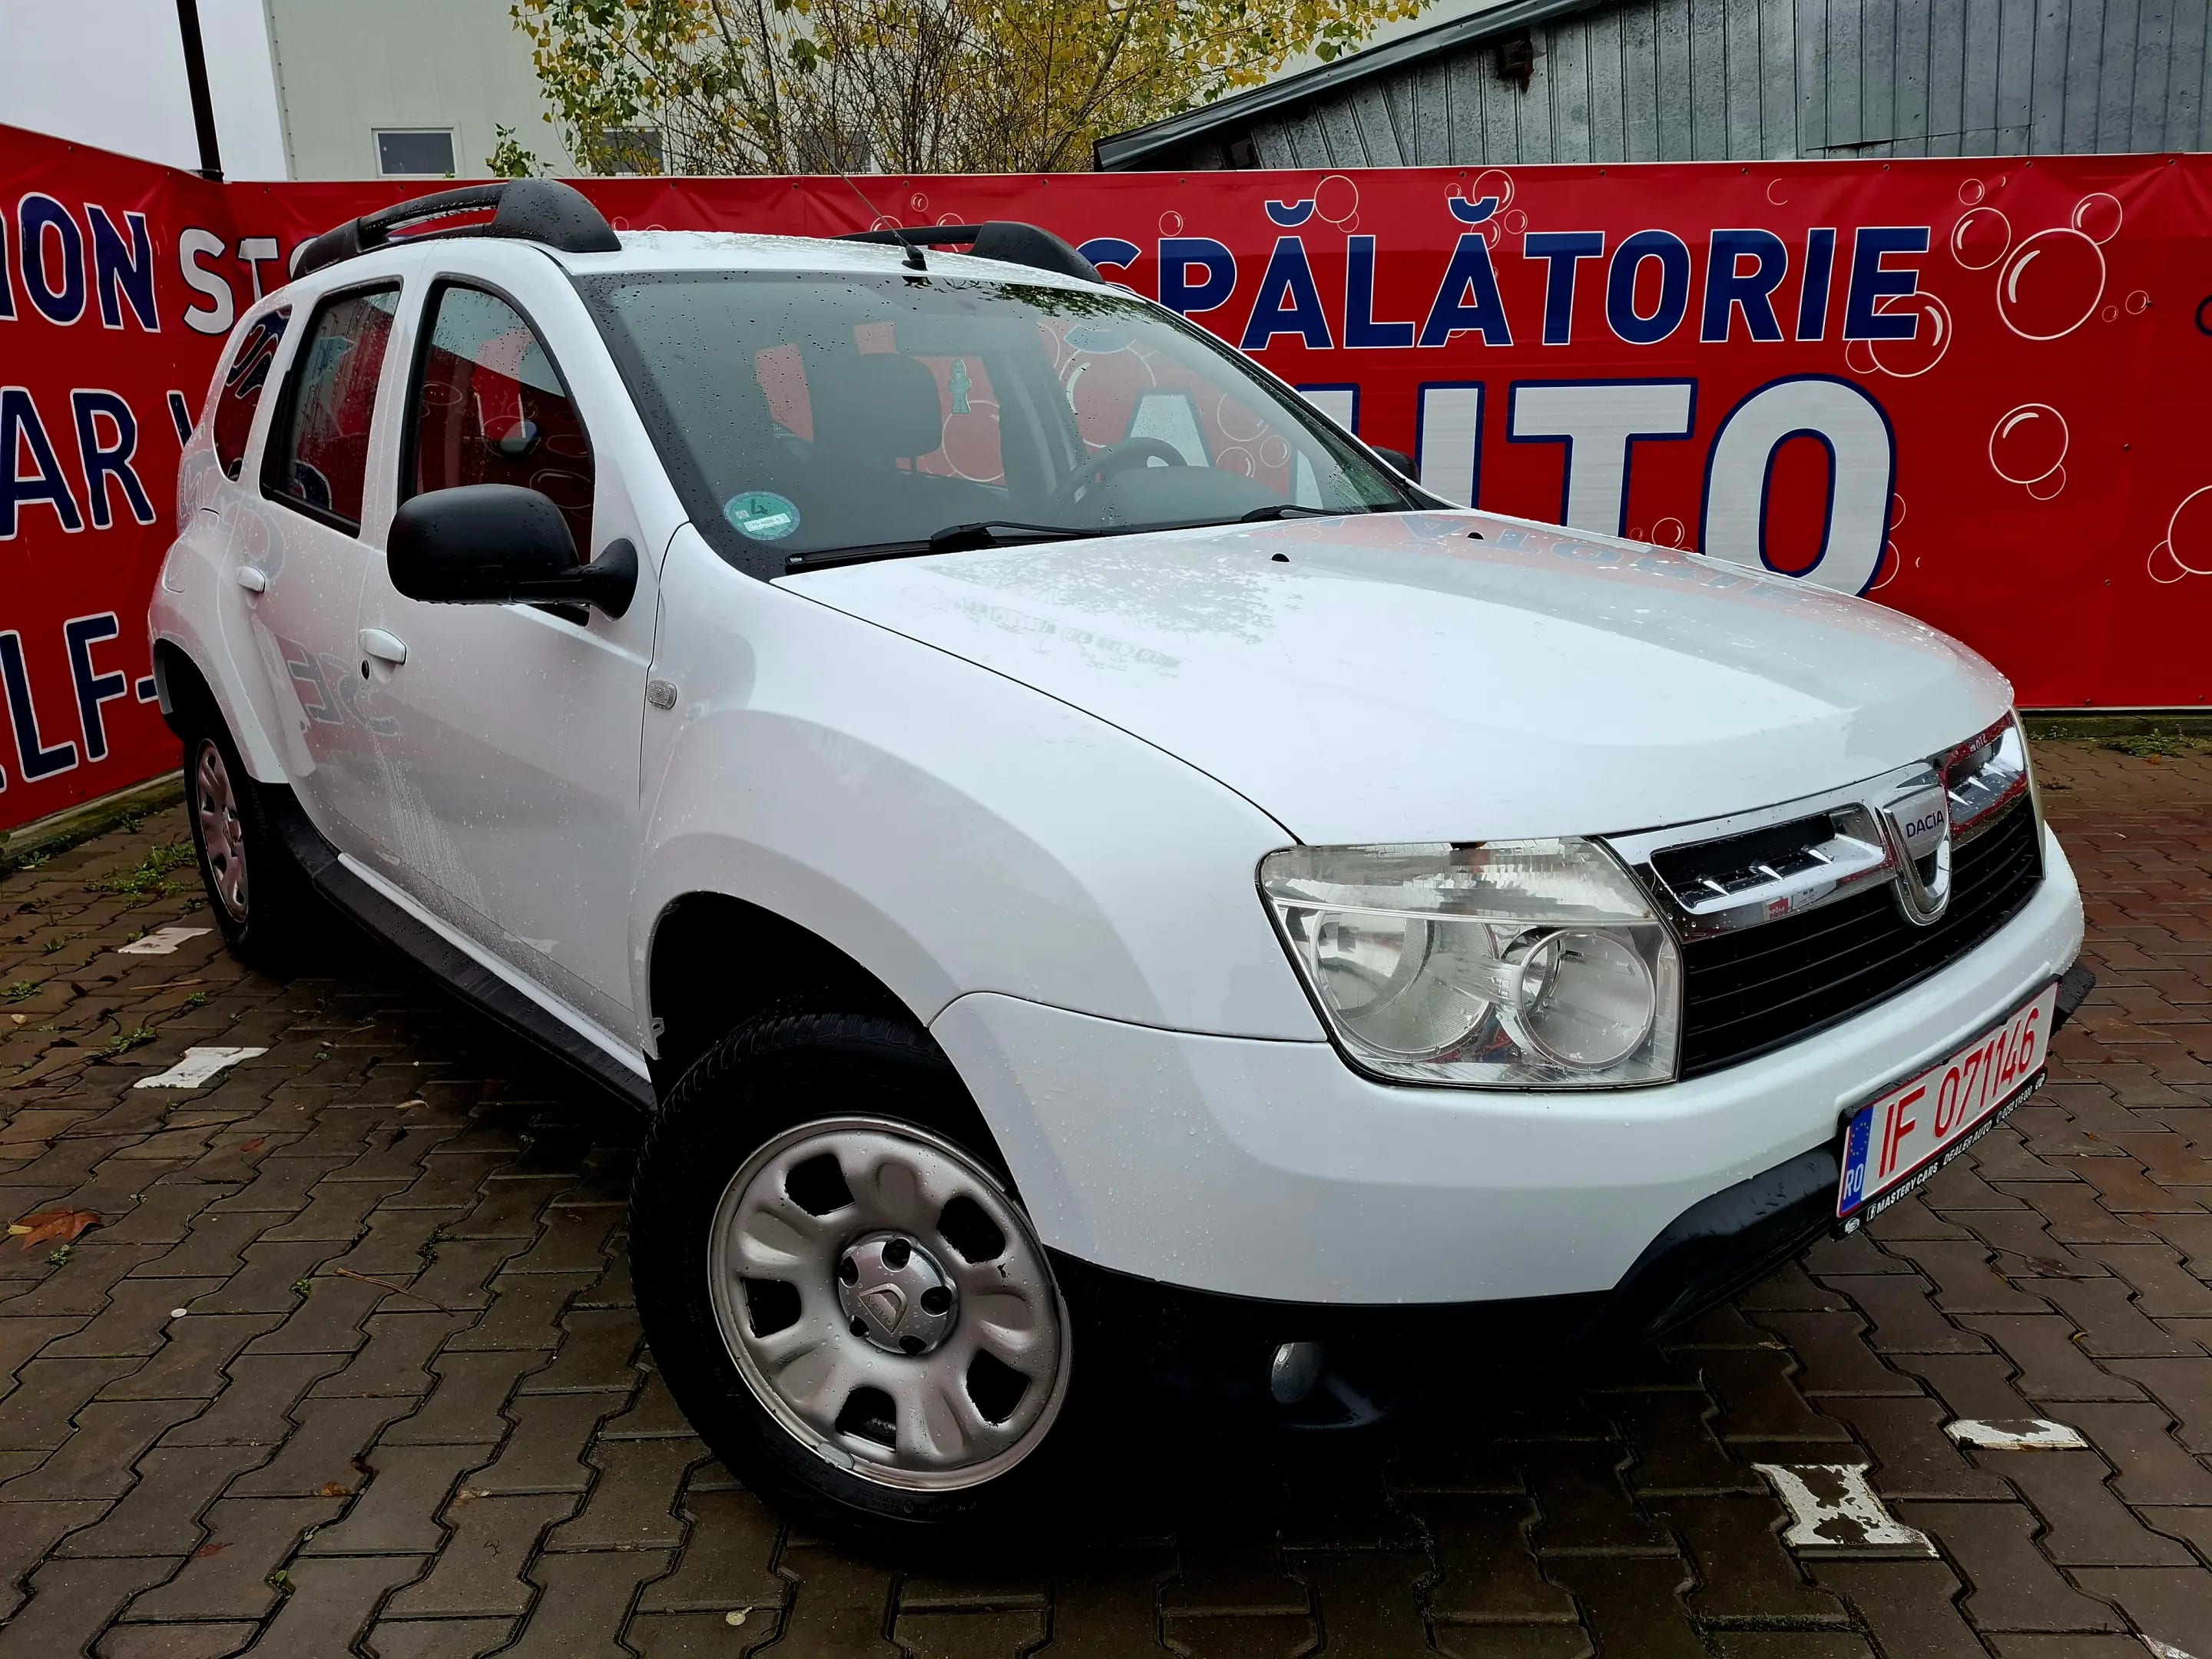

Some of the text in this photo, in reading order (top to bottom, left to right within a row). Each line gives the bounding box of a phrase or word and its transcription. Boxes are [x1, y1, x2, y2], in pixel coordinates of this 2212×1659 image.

[0, 192, 161, 332] ON
[1906, 810, 1945, 839] DACIA
[1879, 1007, 2039, 1180] IF 071146
[1844, 1163, 1864, 1199] RO
[1876, 1177, 1919, 1214] MASTERY
[1917, 1162, 1939, 1186] CARS
[1942, 1134, 1973, 1165] DEALER
[1972, 1120, 1992, 1143] AUTO
